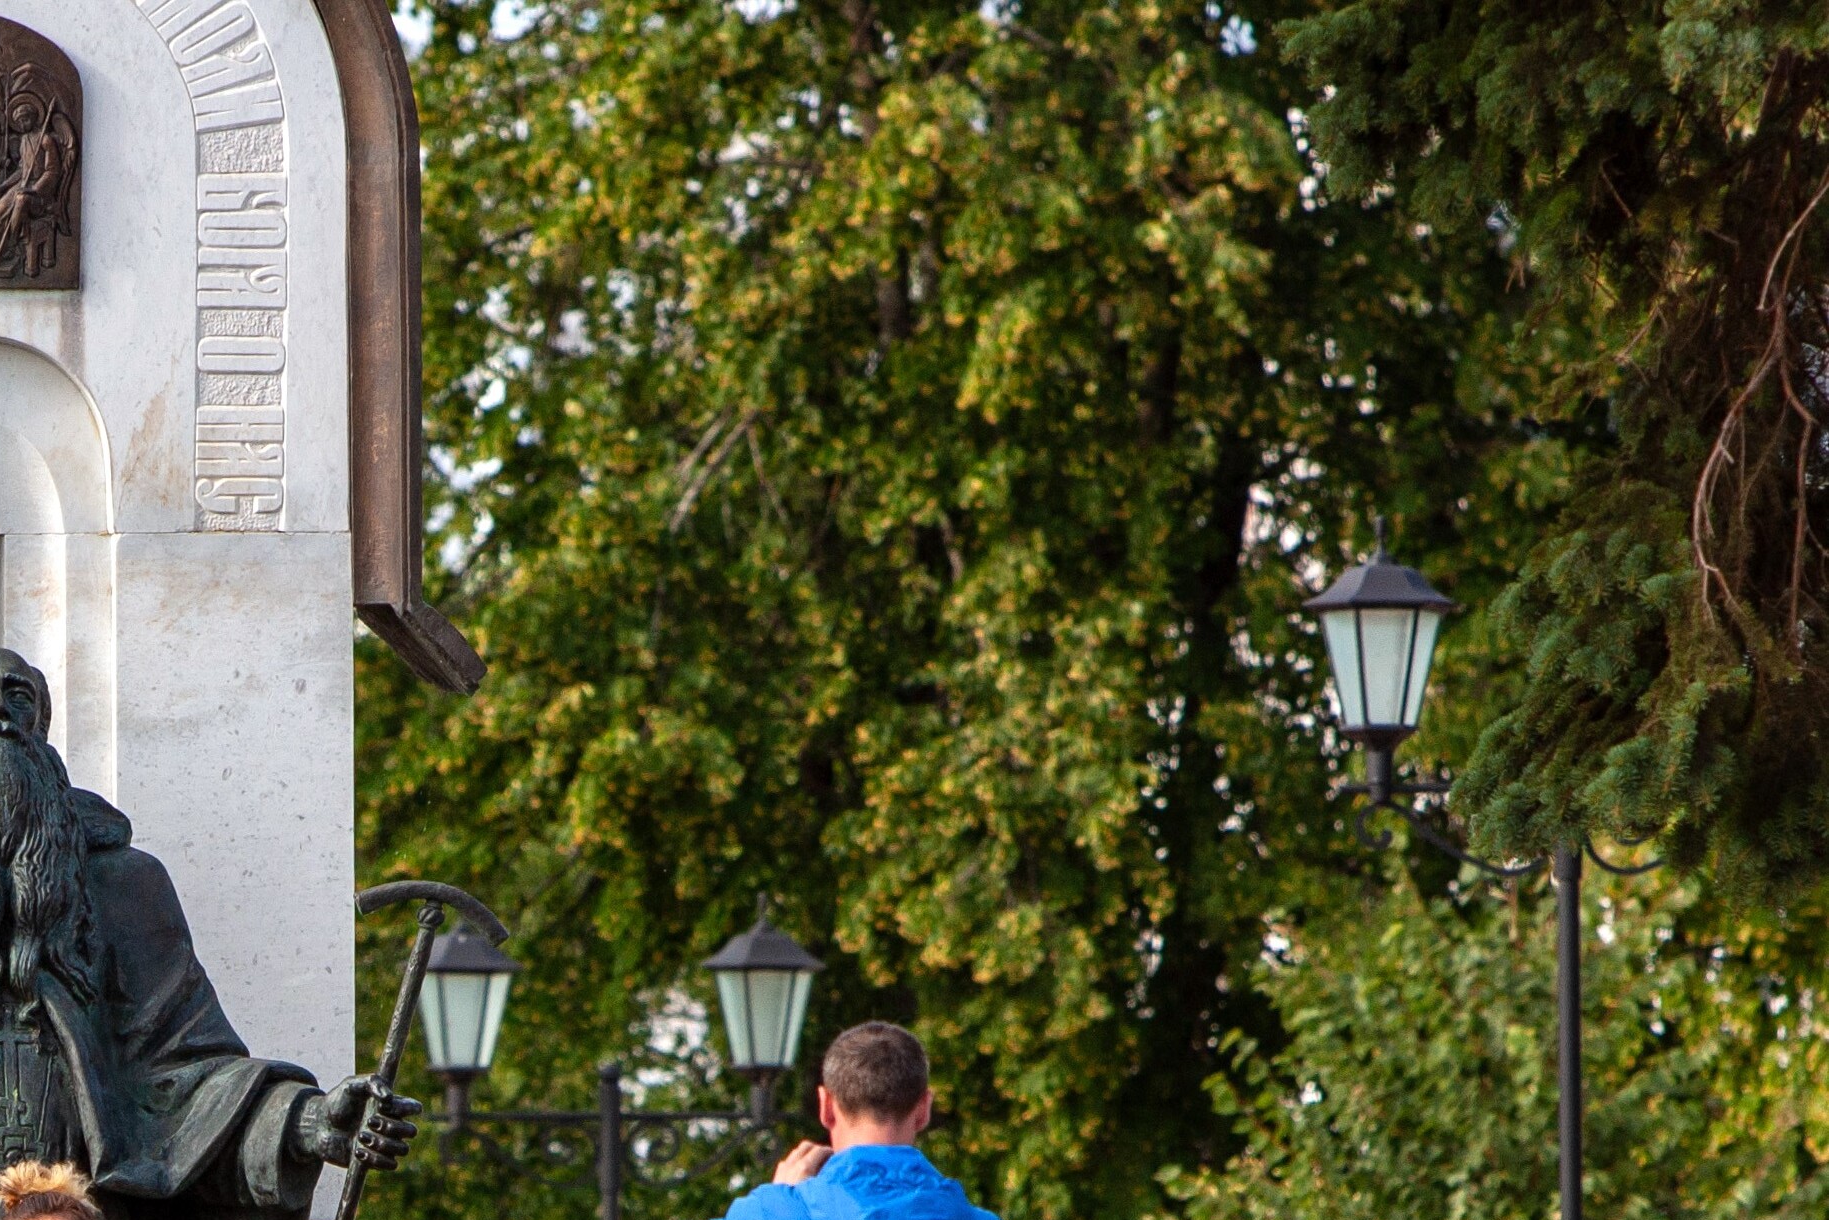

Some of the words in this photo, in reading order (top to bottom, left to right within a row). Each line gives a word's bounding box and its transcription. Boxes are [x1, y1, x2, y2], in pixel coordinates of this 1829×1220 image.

[197, 172, 287, 310] БОГА
[197, 335, 286, 375] О
[195, 404, 285, 515] НАС
